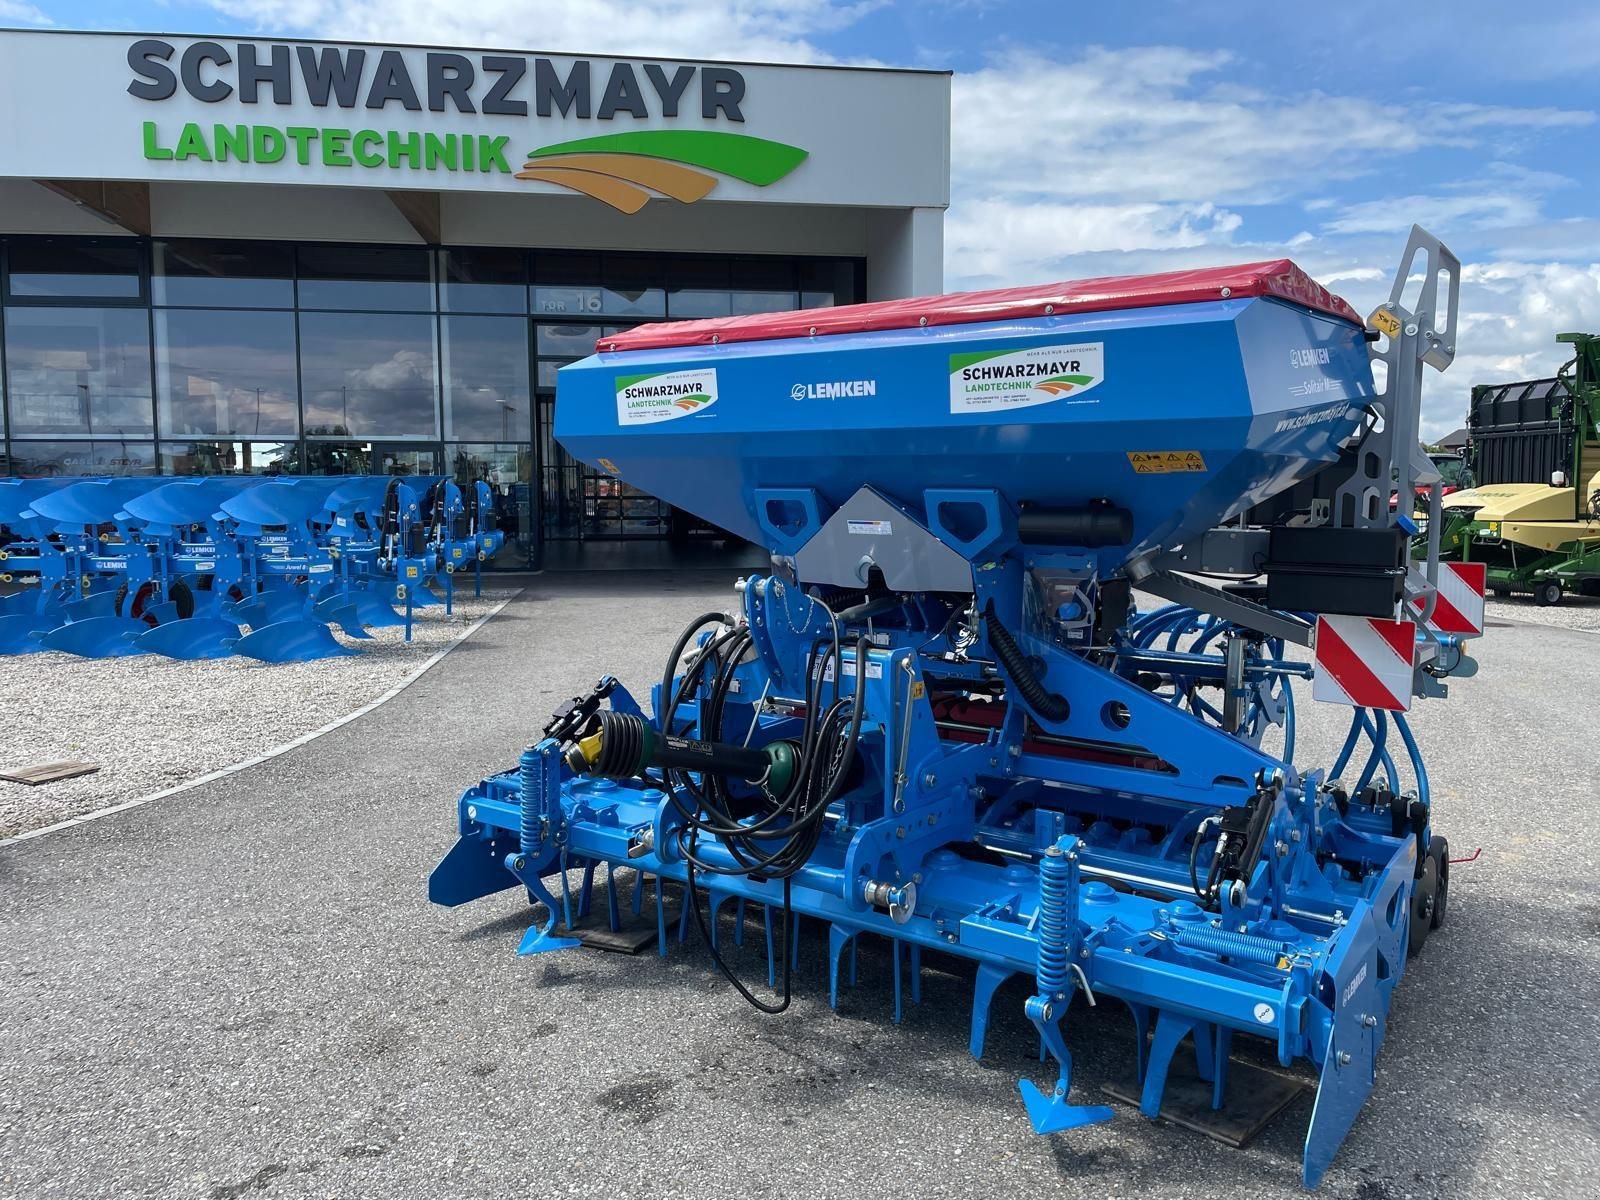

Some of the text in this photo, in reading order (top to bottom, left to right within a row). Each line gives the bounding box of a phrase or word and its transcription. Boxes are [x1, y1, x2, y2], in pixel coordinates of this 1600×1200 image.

[127, 39, 746, 122] SCHWARZMAYR
[143, 121, 511, 173] LANDTECHNIK
[541, 292, 602, 311] TOR 16
[1297, 348, 1330, 367] LEMKEN
[962, 360, 1081, 381] SCHWARZMAYR
[625, 383, 703, 399] SCHWARZMAYR
[807, 380, 876, 400] LEMKEN
[965, 380, 1032, 393] LANDTECHNIK
[627, 398, 672, 409] LANDTECHNIK
[103, 561, 127, 569] LEMKE
